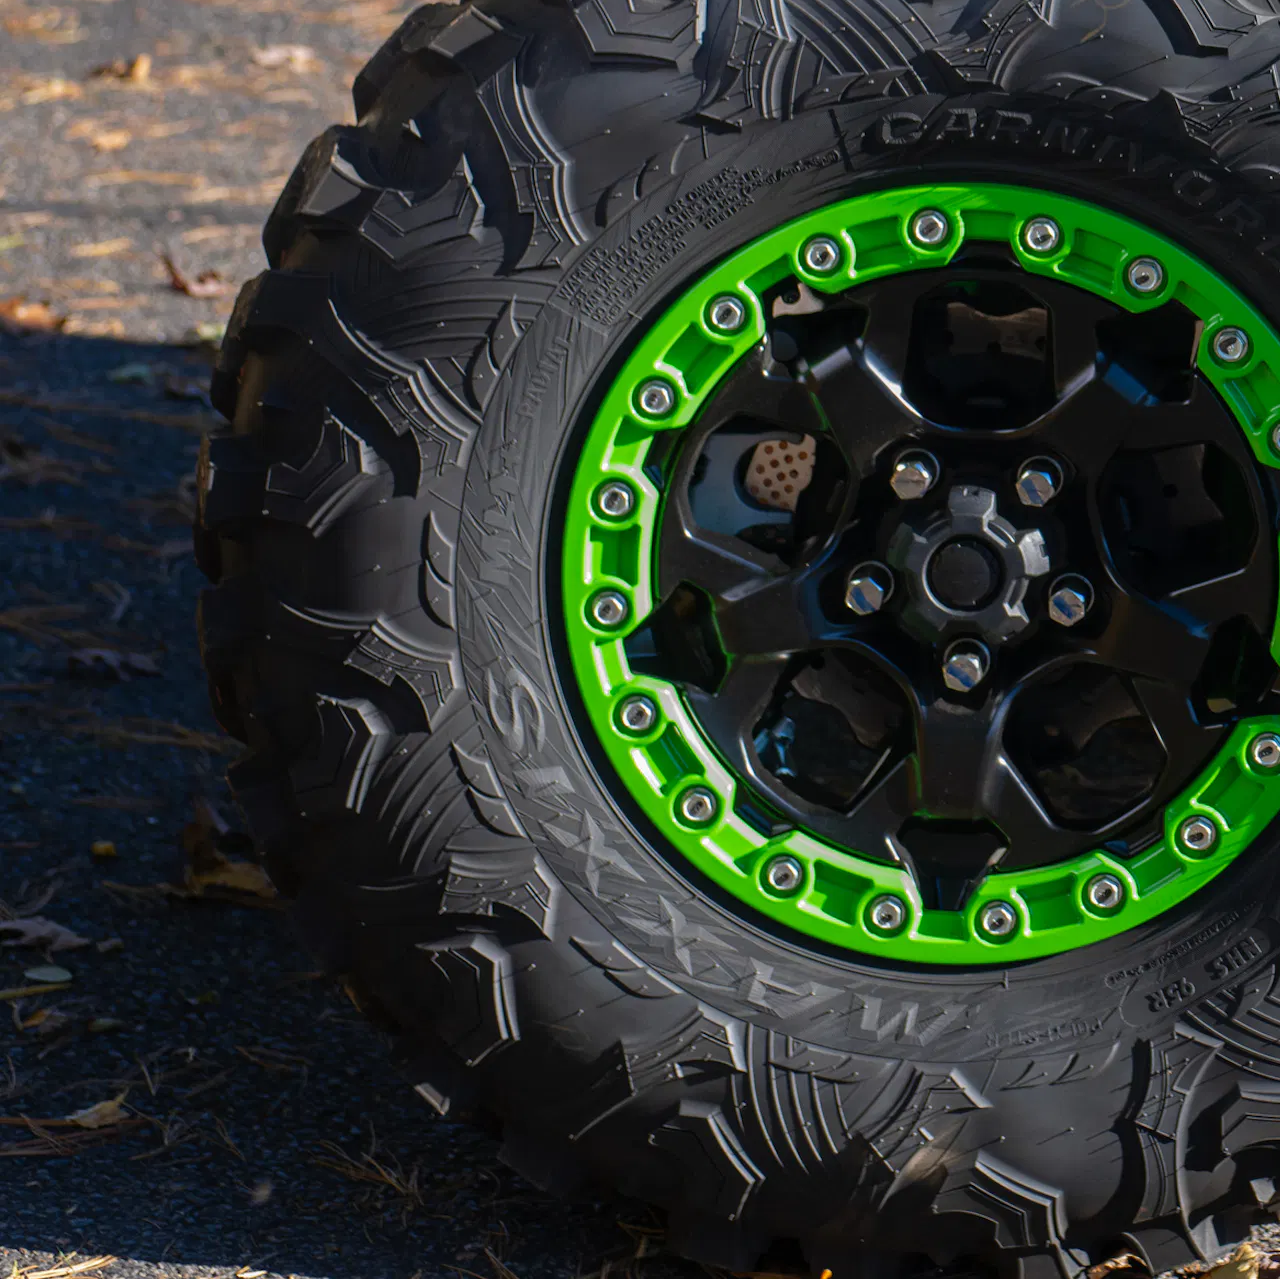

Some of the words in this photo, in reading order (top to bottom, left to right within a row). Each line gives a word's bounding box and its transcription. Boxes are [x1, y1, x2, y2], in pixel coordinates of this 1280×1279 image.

[485, 666, 978, 1044] MAXXIS
[1210, 935, 1264, 981] NHS
[1146, 976, 1196, 1015] 95R
